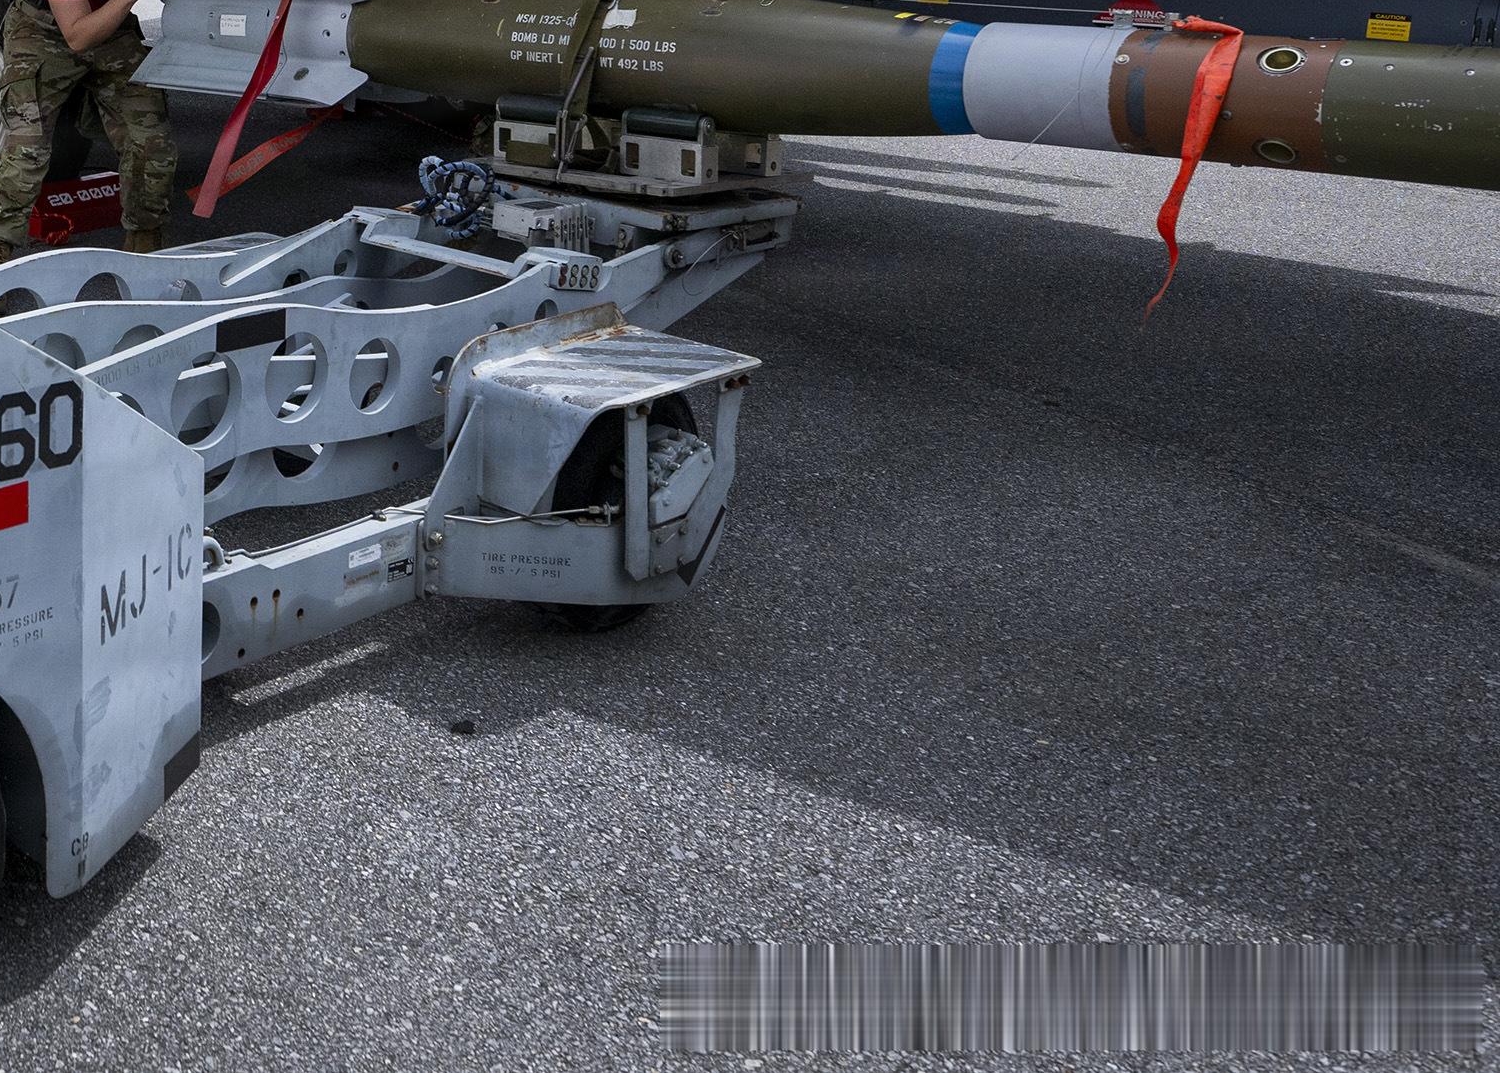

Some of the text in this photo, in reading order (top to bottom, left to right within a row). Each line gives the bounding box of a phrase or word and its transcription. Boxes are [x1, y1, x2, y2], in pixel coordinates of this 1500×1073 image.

[515, 13, 537, 24] NSN
[1107, 7, 1166, 19] WNING
[511, 31, 538, 44] BOMB
[541, 33, 555, 45] LD
[629, 38, 650, 51] 500
[654, 40, 677, 54] LBS
[510, 49, 523, 61] GP
[526, 51, 554, 64] INERT
[618, 58, 639, 71] 492
[642, 59, 665, 72] LBS
[482, 552, 572, 567] TIRE PRESSURE
[490, 565, 505, 575] 95
[530, 568, 538, 577] 5
[542, 568, 561, 579] PSI
[24, 627, 44, 644] PSI
